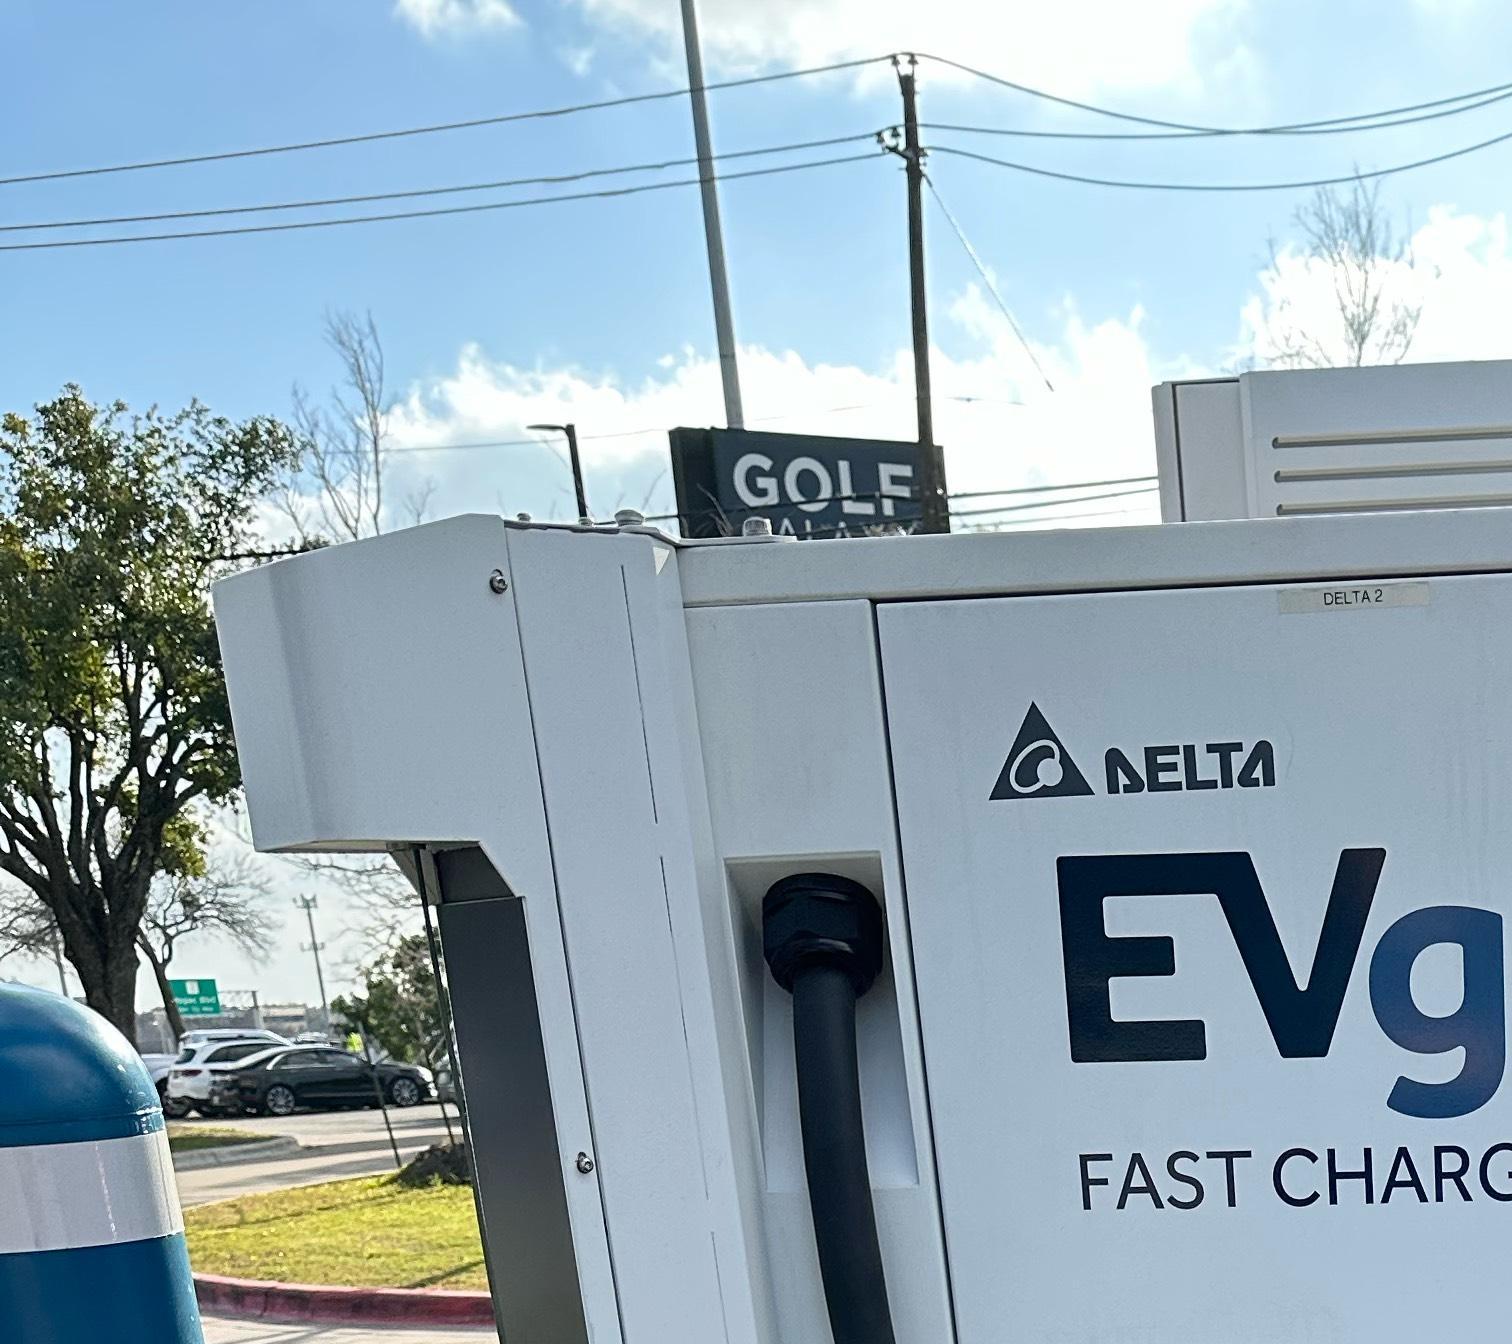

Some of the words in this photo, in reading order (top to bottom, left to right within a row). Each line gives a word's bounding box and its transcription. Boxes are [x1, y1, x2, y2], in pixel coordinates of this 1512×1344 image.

[733, 453, 913, 516] GOLF
[1323, 590, 1371, 607] DELTA
[1373, 589, 1384, 604] 2
[1104, 740, 1276, 795] DELTA
[1079, 1151, 1251, 1211] FAST
